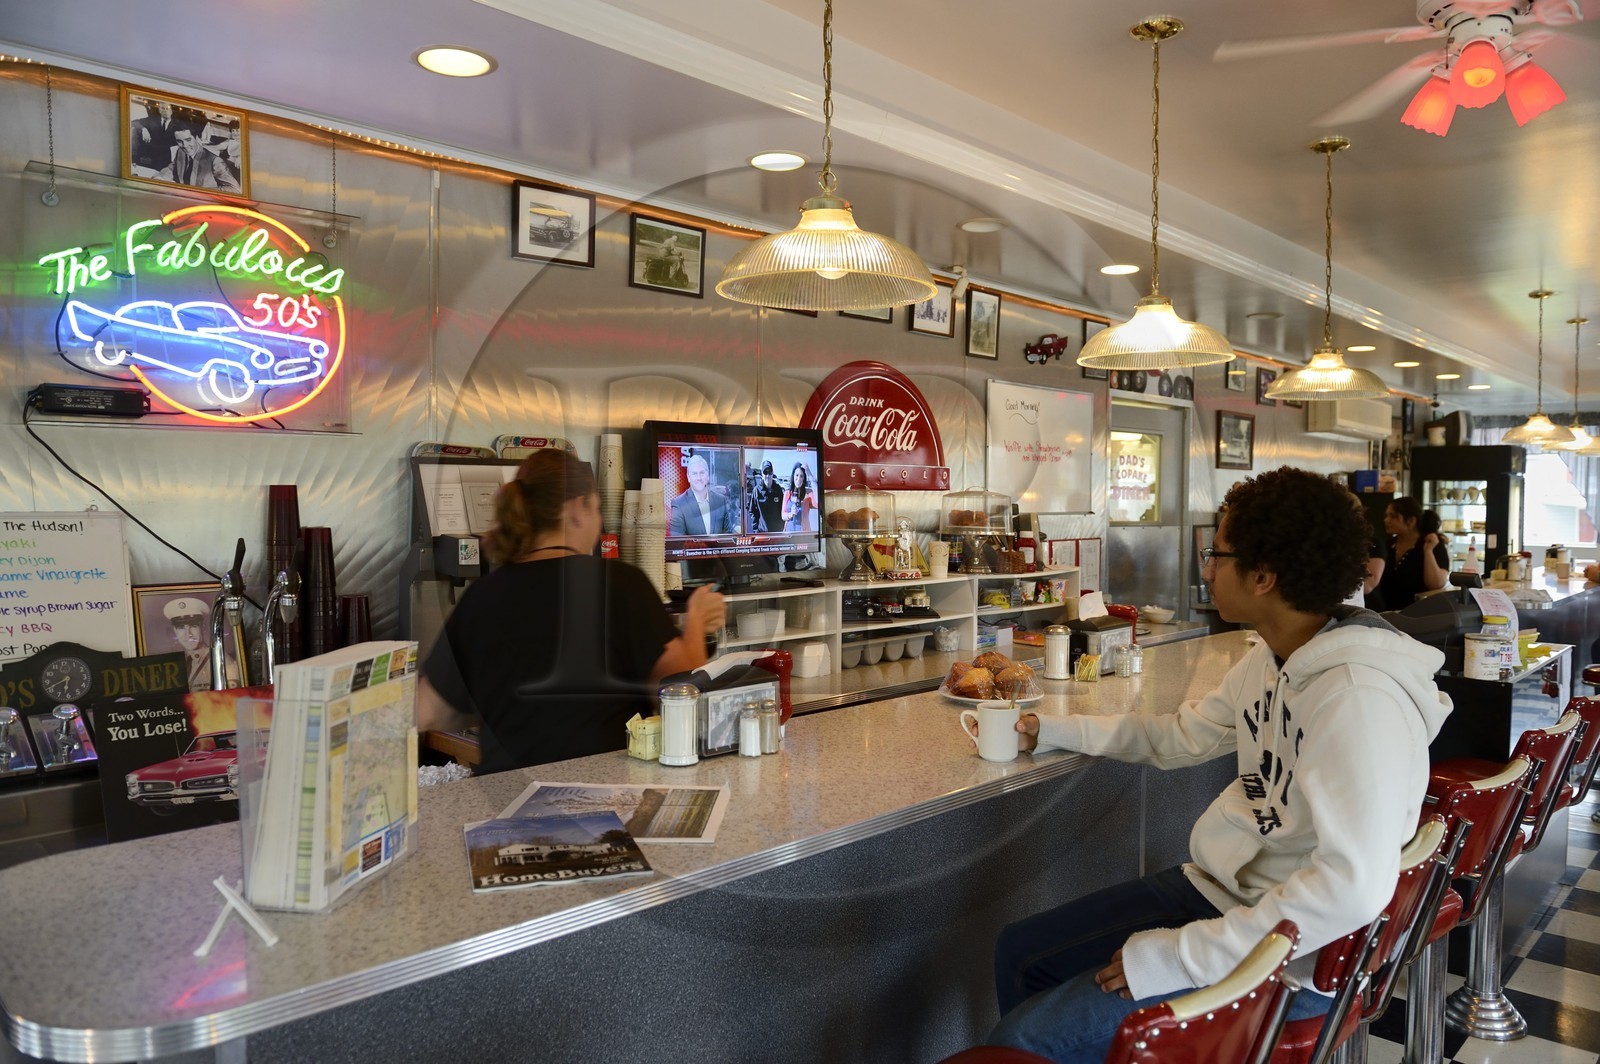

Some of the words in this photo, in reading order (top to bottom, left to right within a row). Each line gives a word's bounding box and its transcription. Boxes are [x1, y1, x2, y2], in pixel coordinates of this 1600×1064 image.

[39, 247, 113, 294] The
[125, 219, 345, 293] Fabulous
[243, 292, 322, 330] 50's
[849, 396, 885, 409] DRINK
[823, 402, 920, 452] Coca-Cola
[1119, 455, 1145, 468] DAD'S
[880, 468, 948, 480] COLD
[1116, 469, 1148, 483] COPAKE
[1110, 486, 1150, 500] DINER
[3, 521, 26, 531] The
[31, 520, 84, 535] Hudson!
[18, 556, 56, 568] Dijon
[0, 573, 32, 581] amic
[36, 568, 109, 584] Vinaigrette
[48, 601, 83, 613] Brown
[21, 622, 52, 634] BBQ
[101, 662, 185, 697] DINER
[108, 712, 134, 723] Two
[136, 706, 184, 719] Words...
[107, 726, 139, 741] You
[143, 718, 187, 737] Lose!
[479, 861, 644, 887] HomeBuyers
